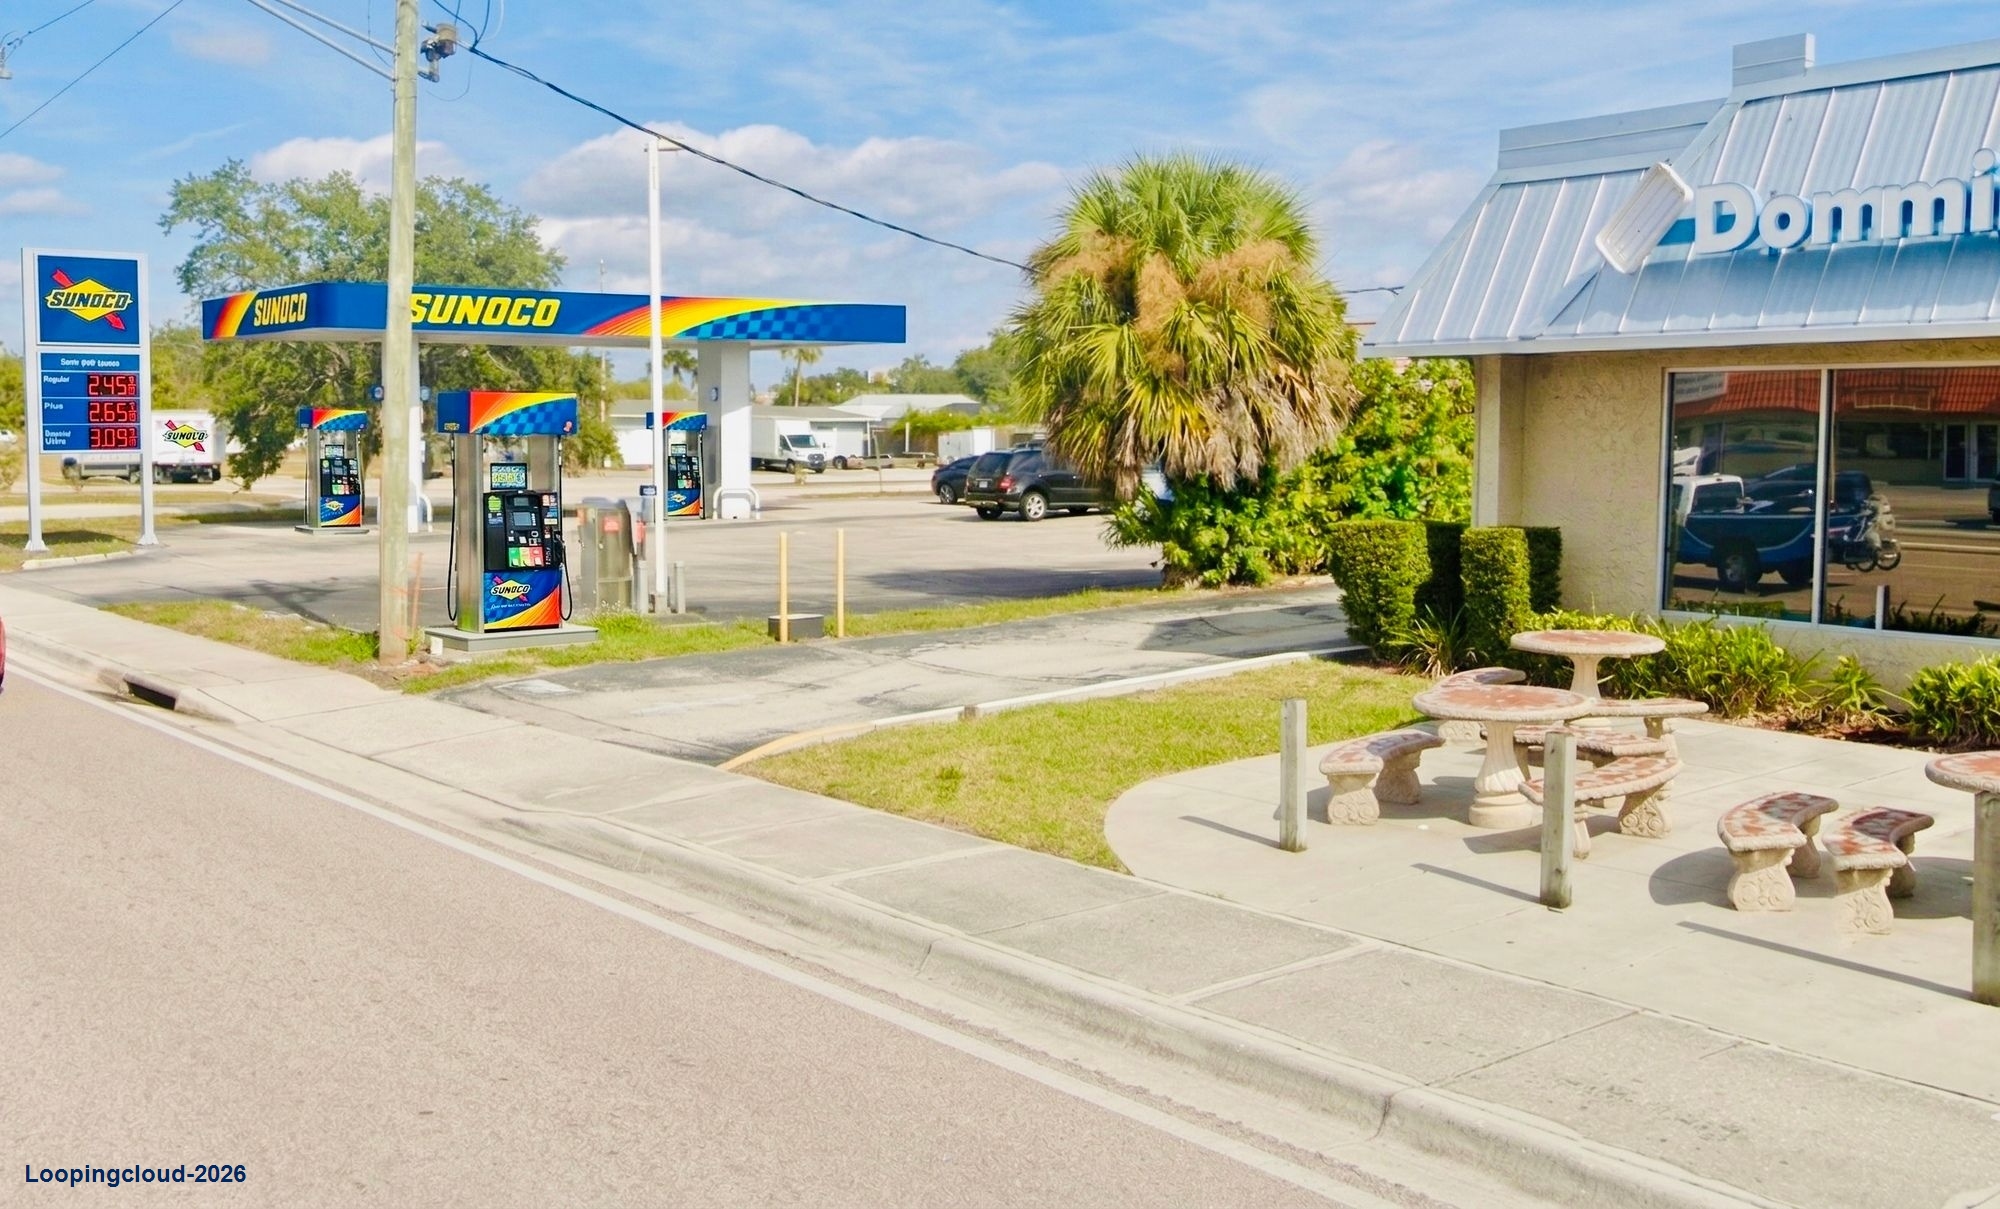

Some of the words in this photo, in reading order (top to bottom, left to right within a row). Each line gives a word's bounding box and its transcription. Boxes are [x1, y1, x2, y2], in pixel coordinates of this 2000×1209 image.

[1695, 147, 1996, 255] Dommi
[49, 291, 130, 309] SUNOCO
[253, 292, 307, 327] SUNOCO
[410, 293, 561, 327] SUNOCO
[88, 375, 127, 396] 2.45
[89, 402, 128, 422] 2.65
[492, 585, 530, 595] SUNOCO
